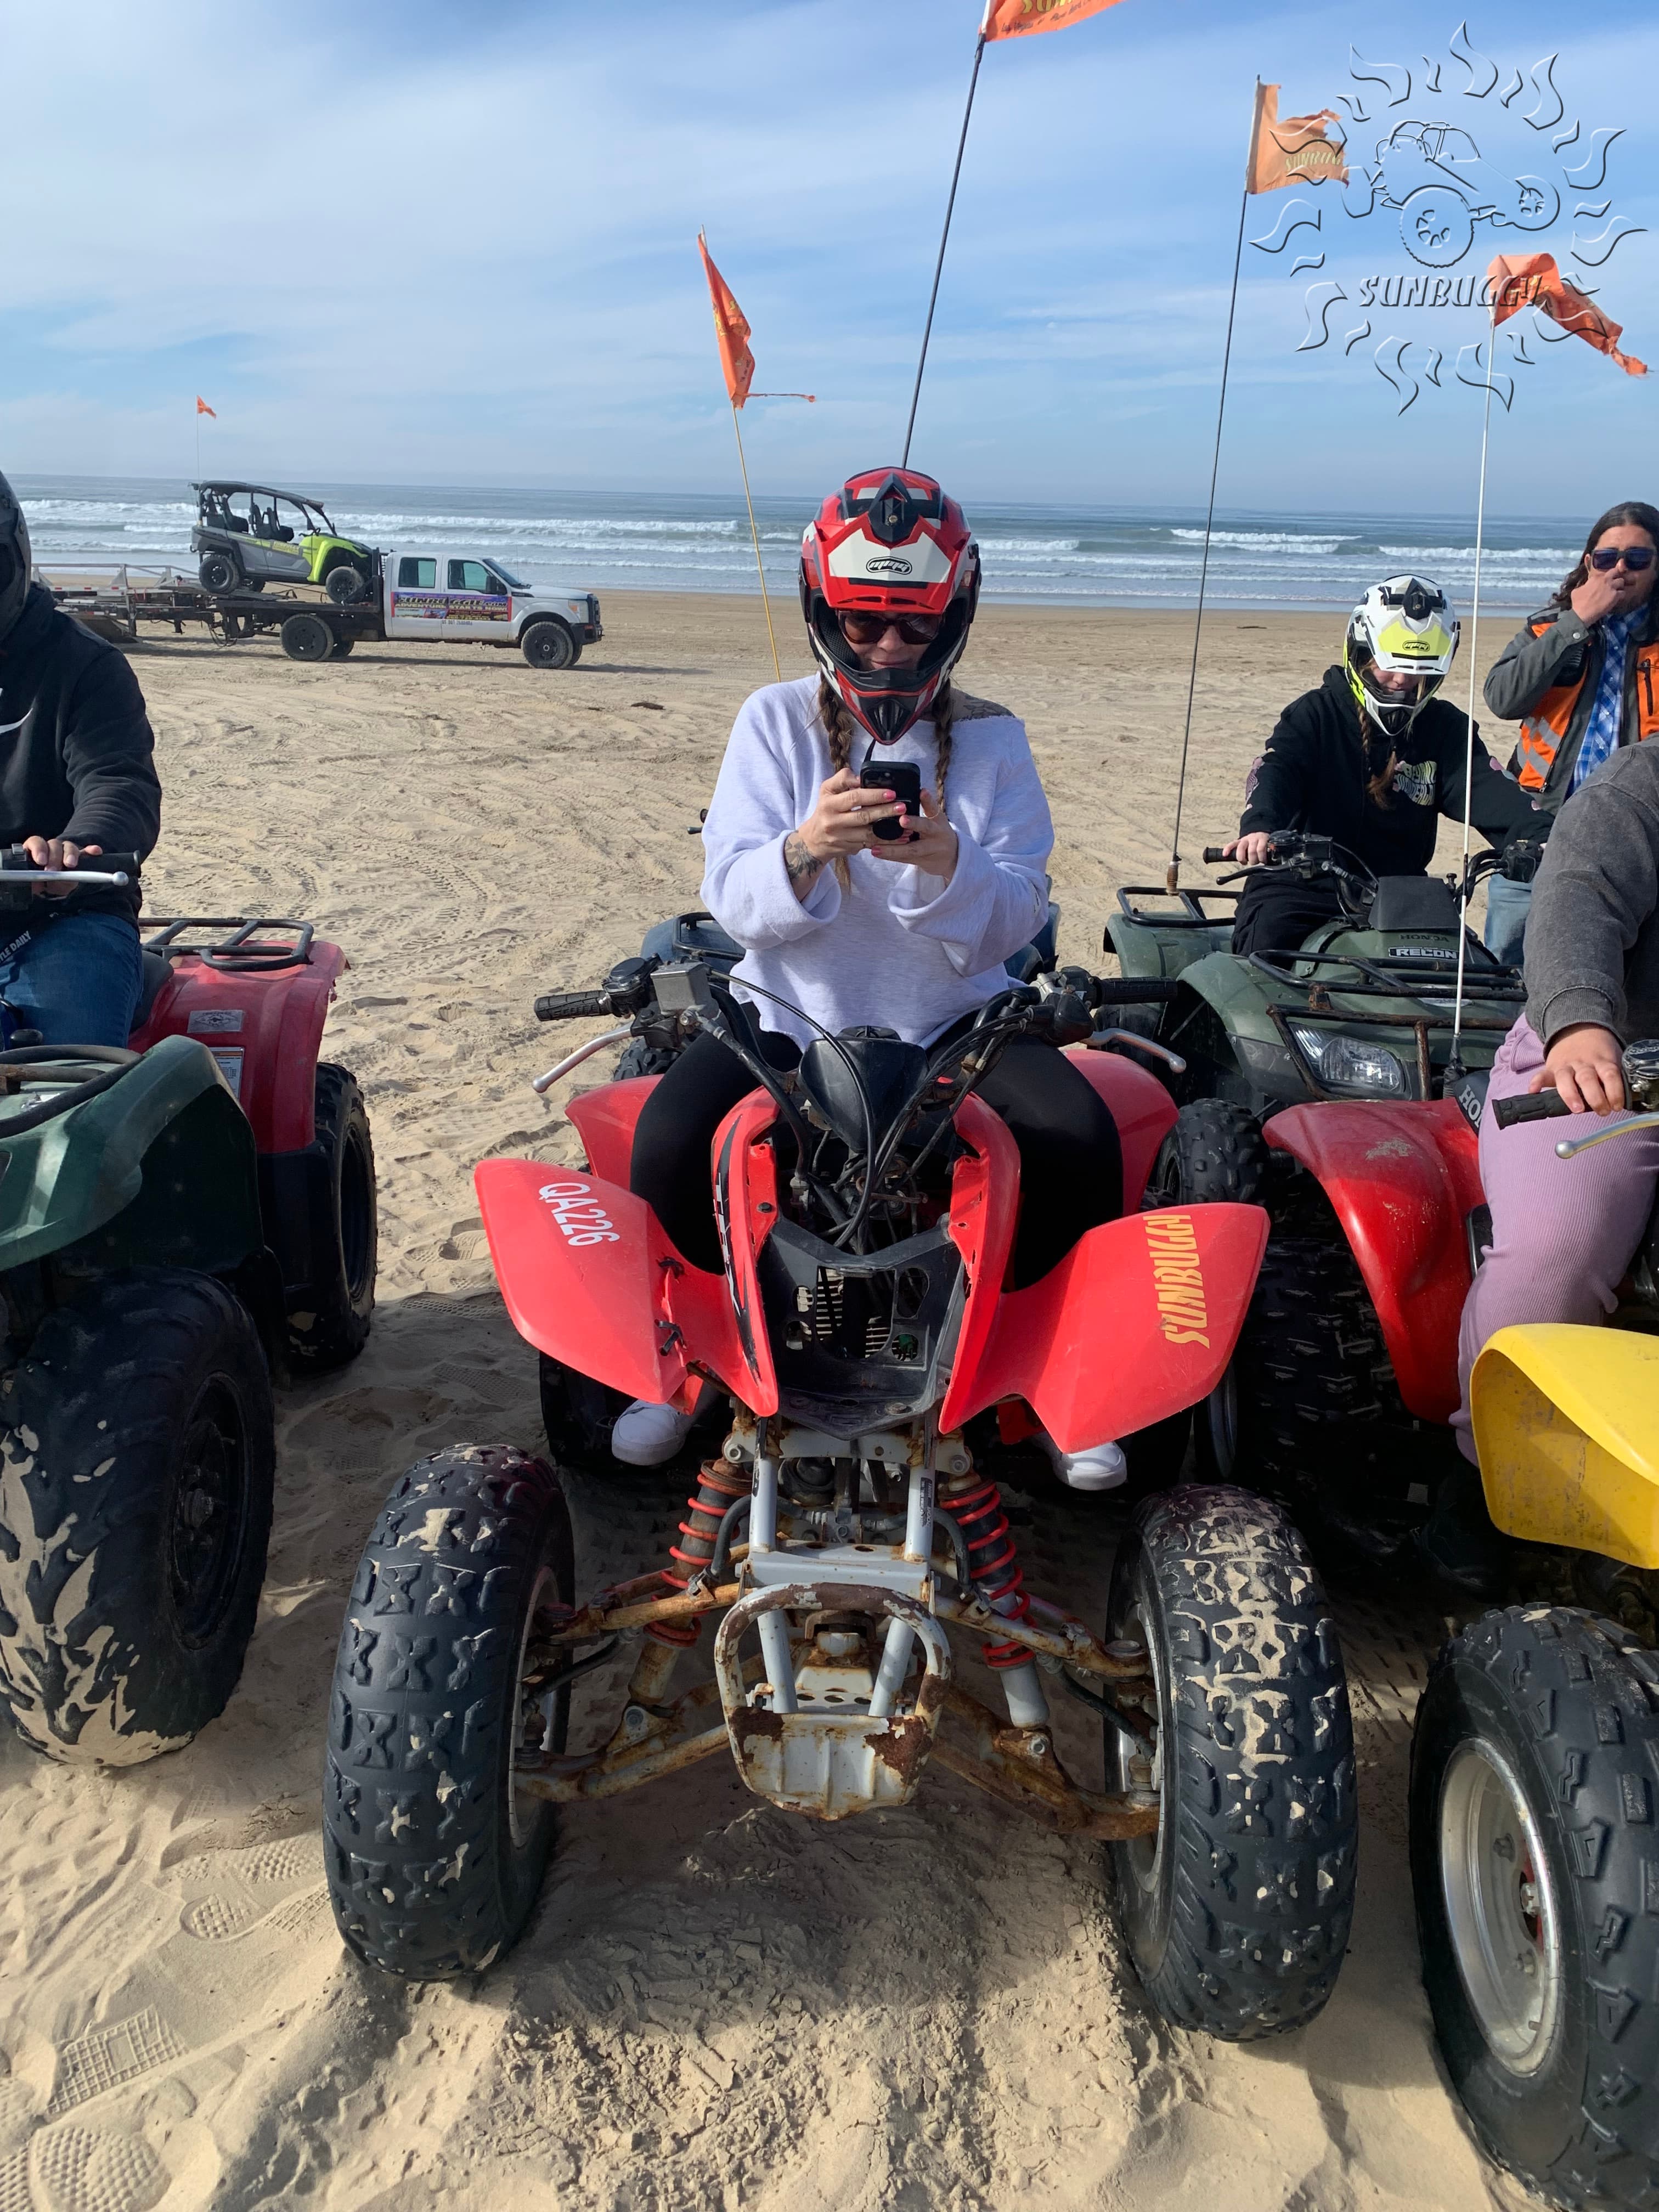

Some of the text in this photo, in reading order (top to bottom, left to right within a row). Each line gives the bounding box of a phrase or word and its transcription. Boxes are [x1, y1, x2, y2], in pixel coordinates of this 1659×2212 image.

[9, 930, 31, 952] DAILY
[1396, 949, 1457, 959] RECON
[539, 1182, 620, 1246] QA226
[1143, 1215, 1210, 1349] SUNBUGGY
